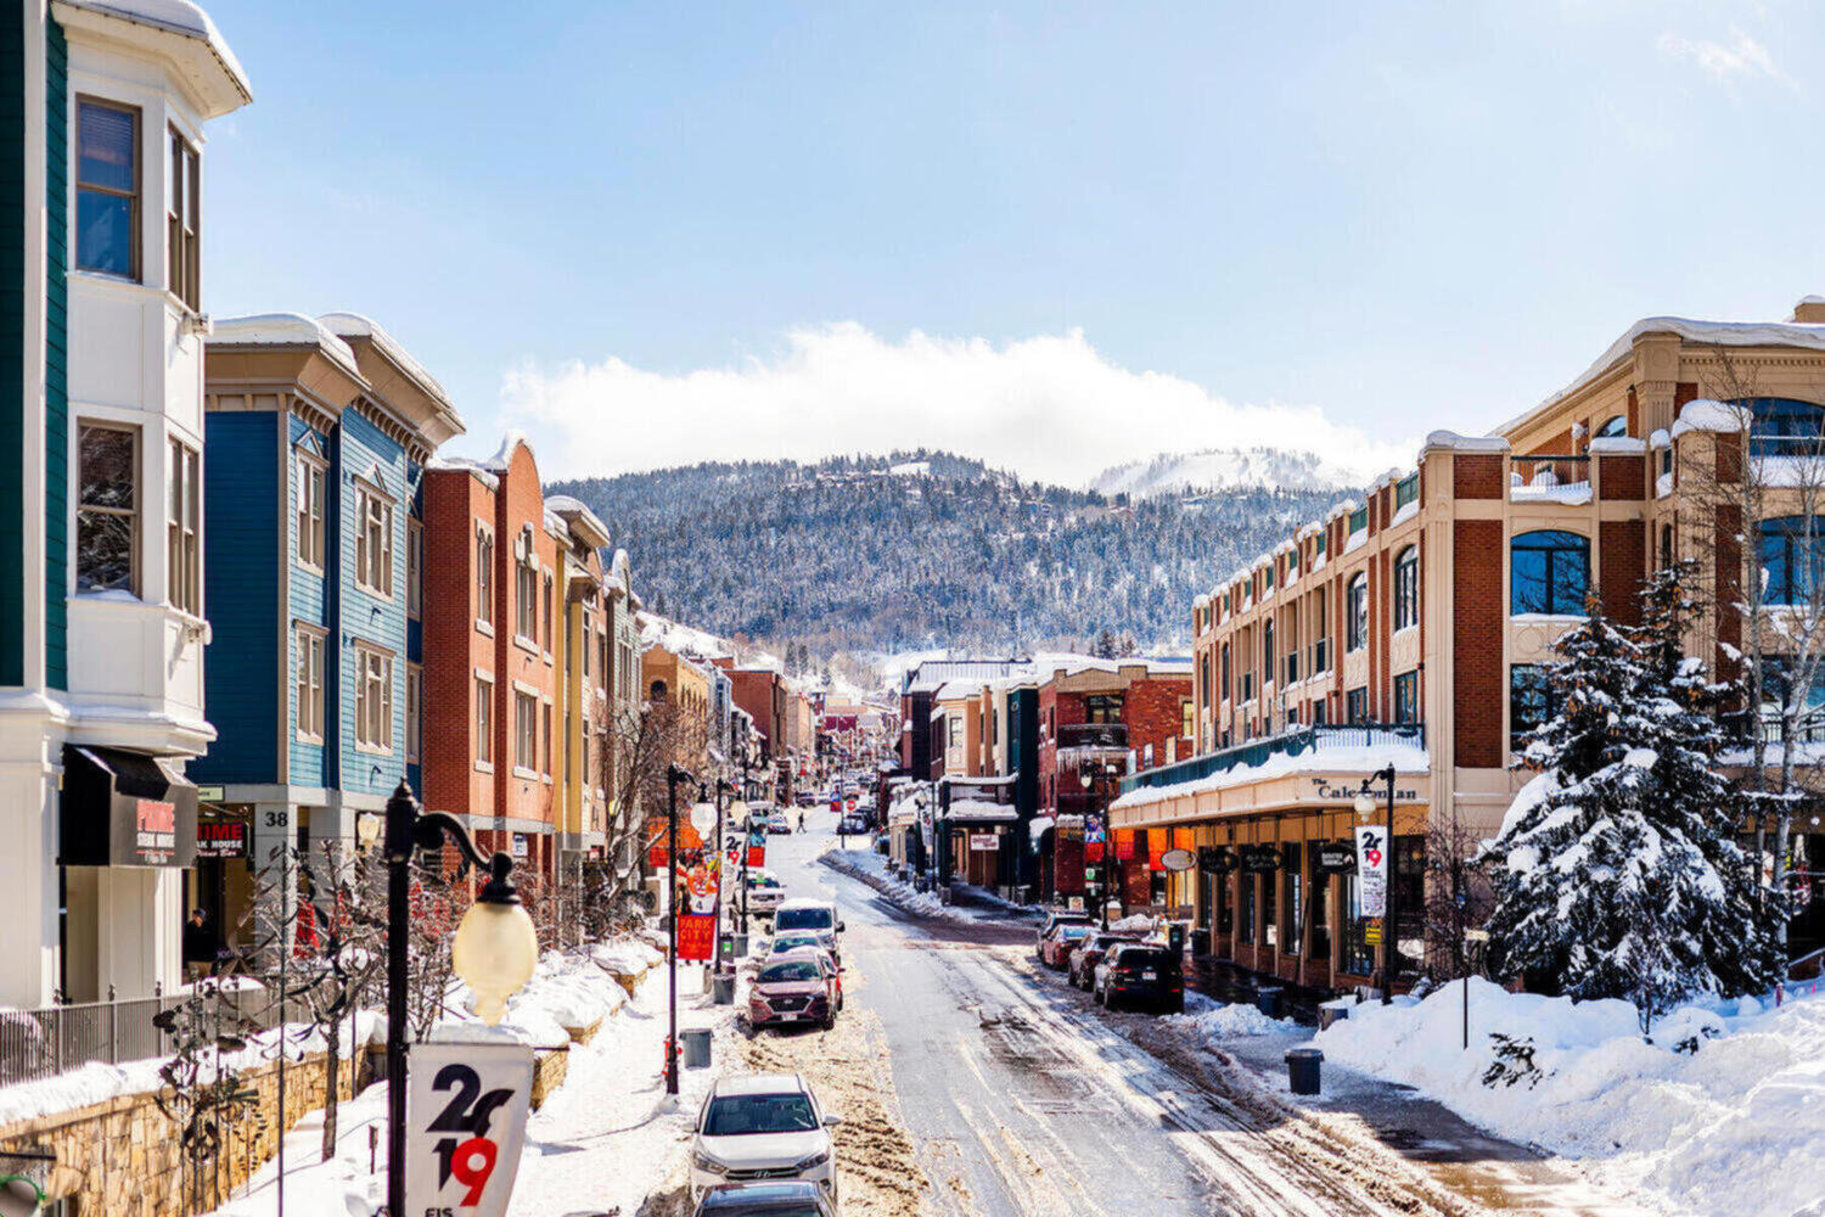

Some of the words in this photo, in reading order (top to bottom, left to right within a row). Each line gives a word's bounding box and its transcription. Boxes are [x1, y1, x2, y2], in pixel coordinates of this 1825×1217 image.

[1318, 785, 1416, 799] Caleonan
[265, 812, 287, 827] 38
[211, 840, 242, 848] HOUSE
[680, 919, 711, 928] PARK
[680, 929, 711, 940] CITY
[432, 1137, 498, 1207] 19
